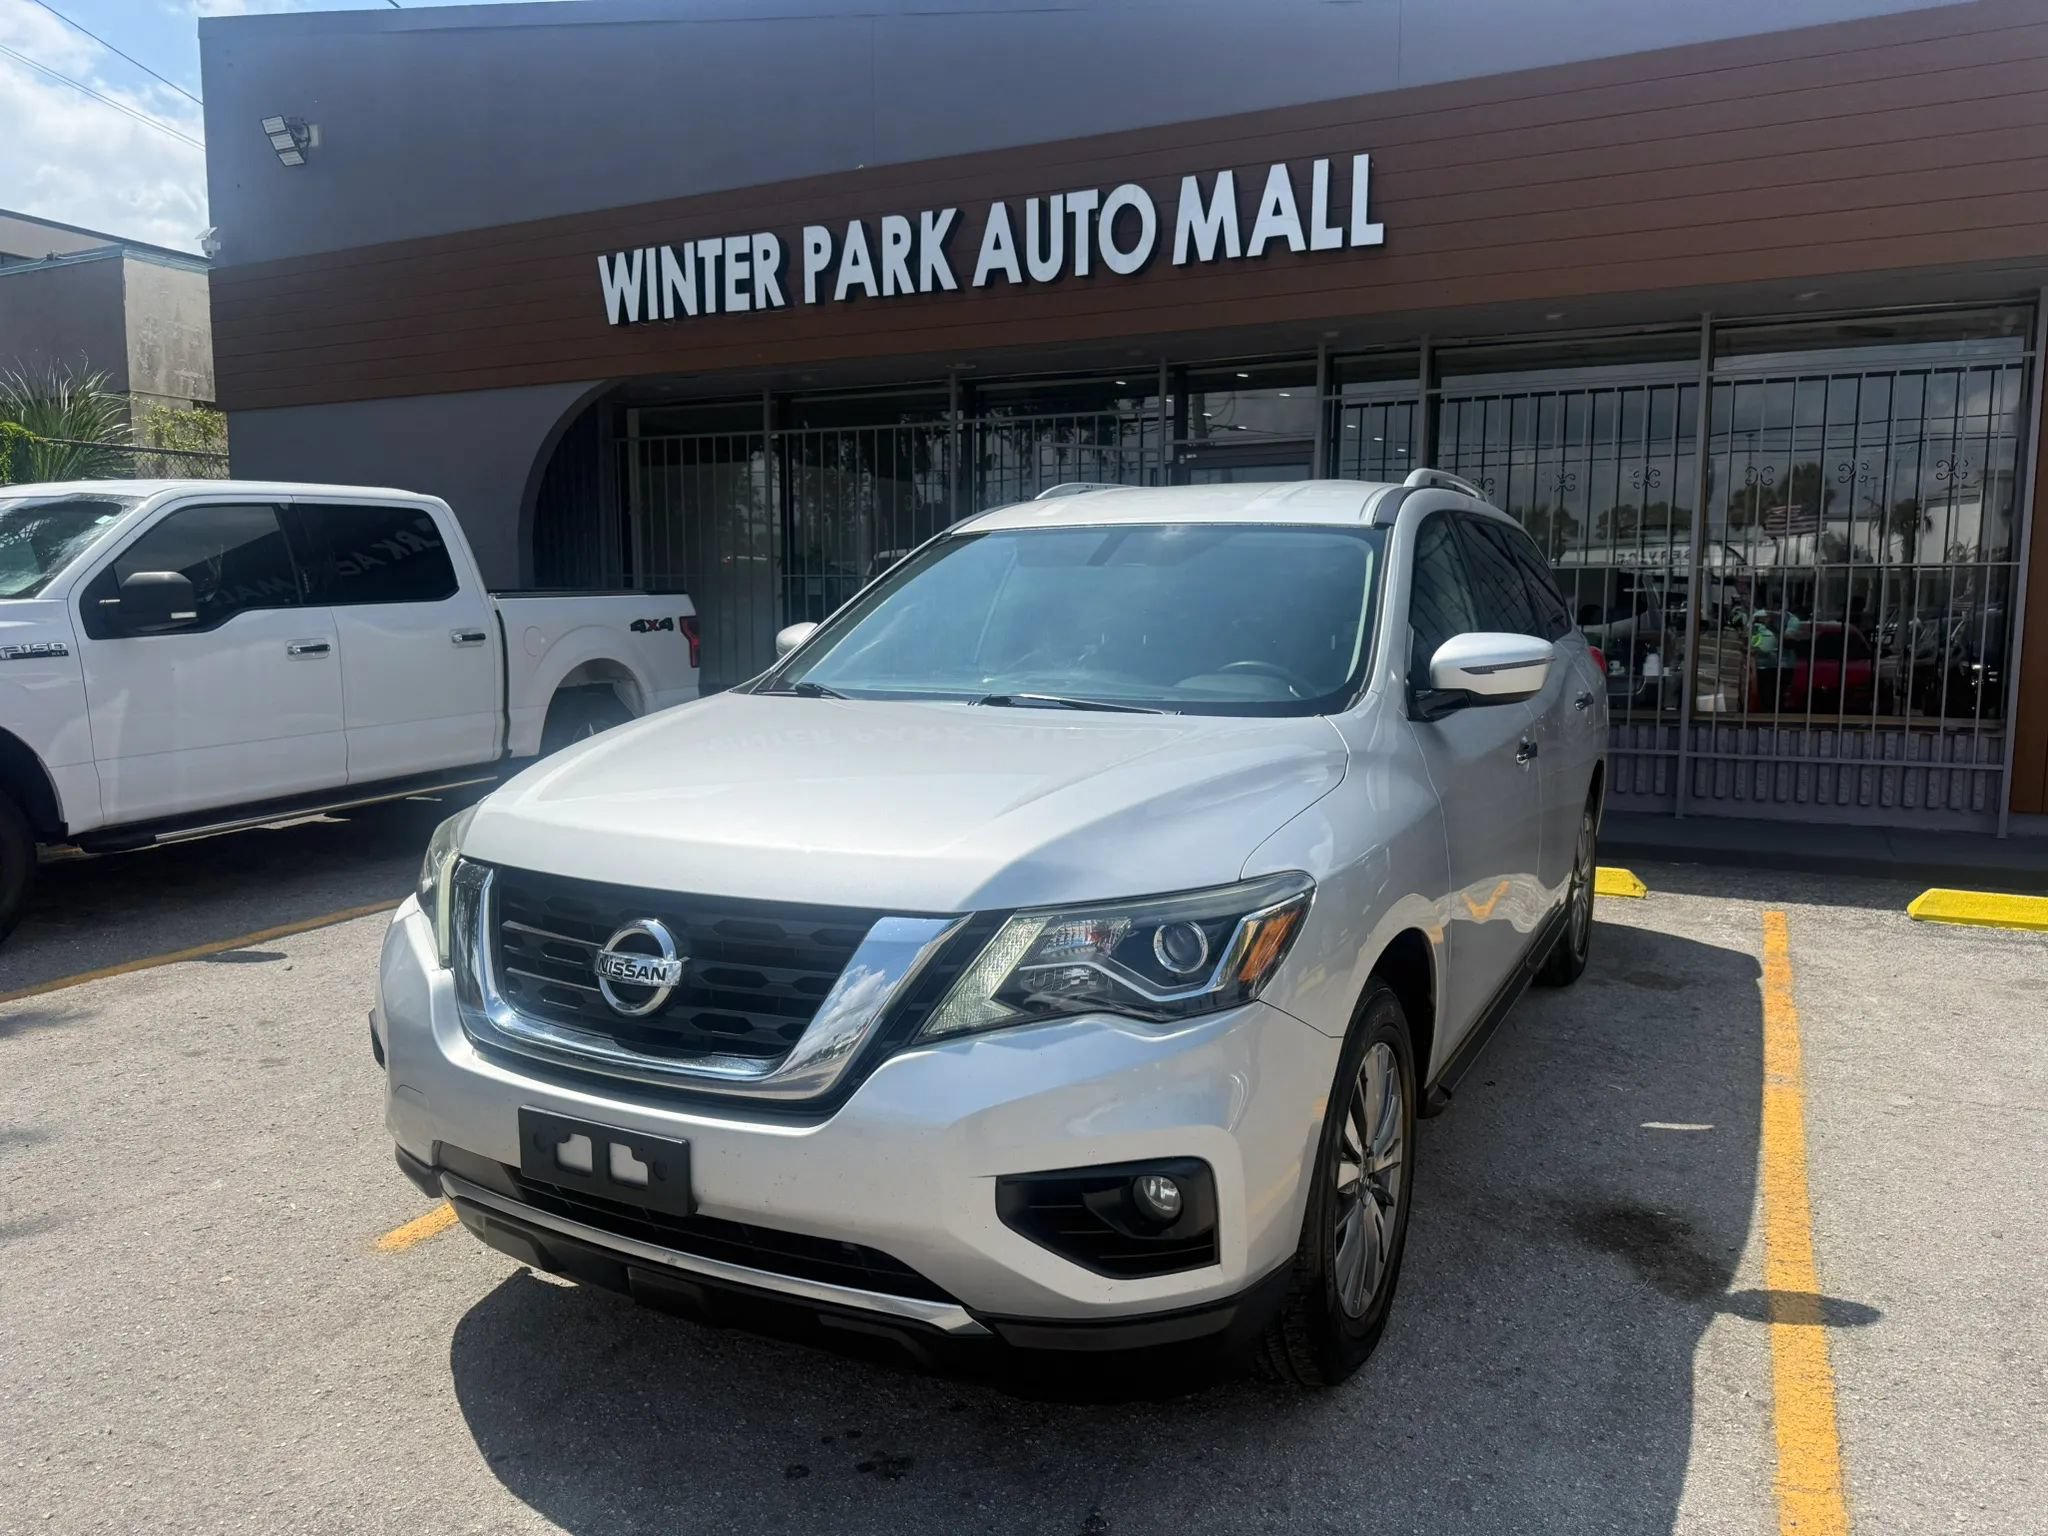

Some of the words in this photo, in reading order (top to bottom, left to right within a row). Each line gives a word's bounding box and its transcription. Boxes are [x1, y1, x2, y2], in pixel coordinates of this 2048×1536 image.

[597, 231, 785, 325] WINTER
[803, 207, 959, 304] PARK
[972, 183, 1157, 287] AUTO
[1172, 153, 1385, 266] MALL
[598, 957, 667, 981] NISSAN
